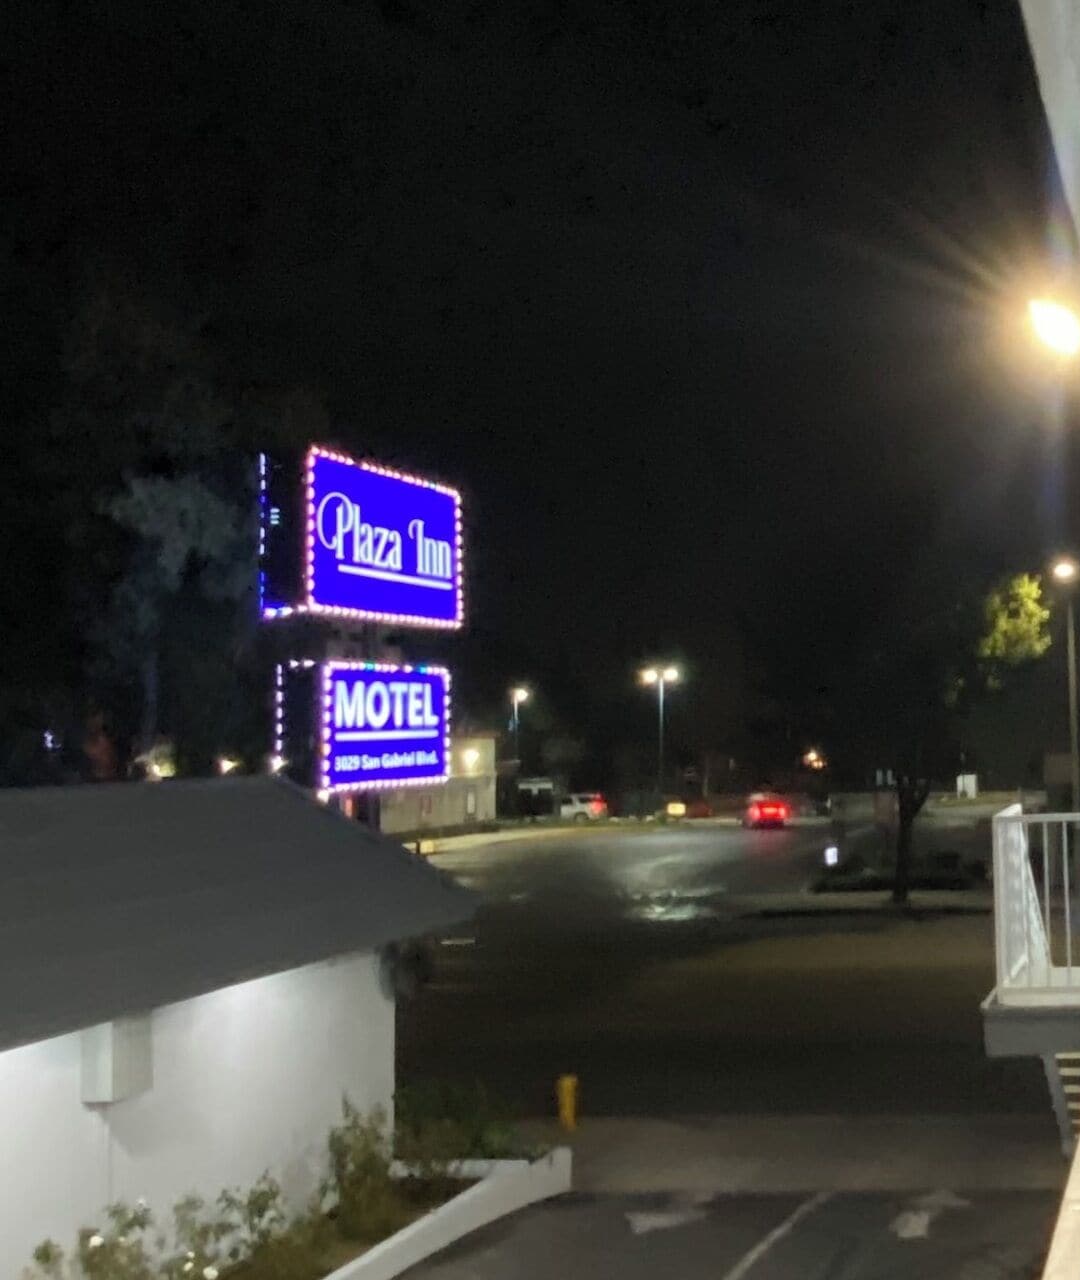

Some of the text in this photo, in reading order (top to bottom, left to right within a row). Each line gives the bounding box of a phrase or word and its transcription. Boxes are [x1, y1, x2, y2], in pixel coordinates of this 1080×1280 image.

[316, 491, 452, 579] Plaza Inn
[334, 681, 439, 728] MOTEL
[361, 754, 380, 770] San
[381, 752, 415, 769] Gabriel
